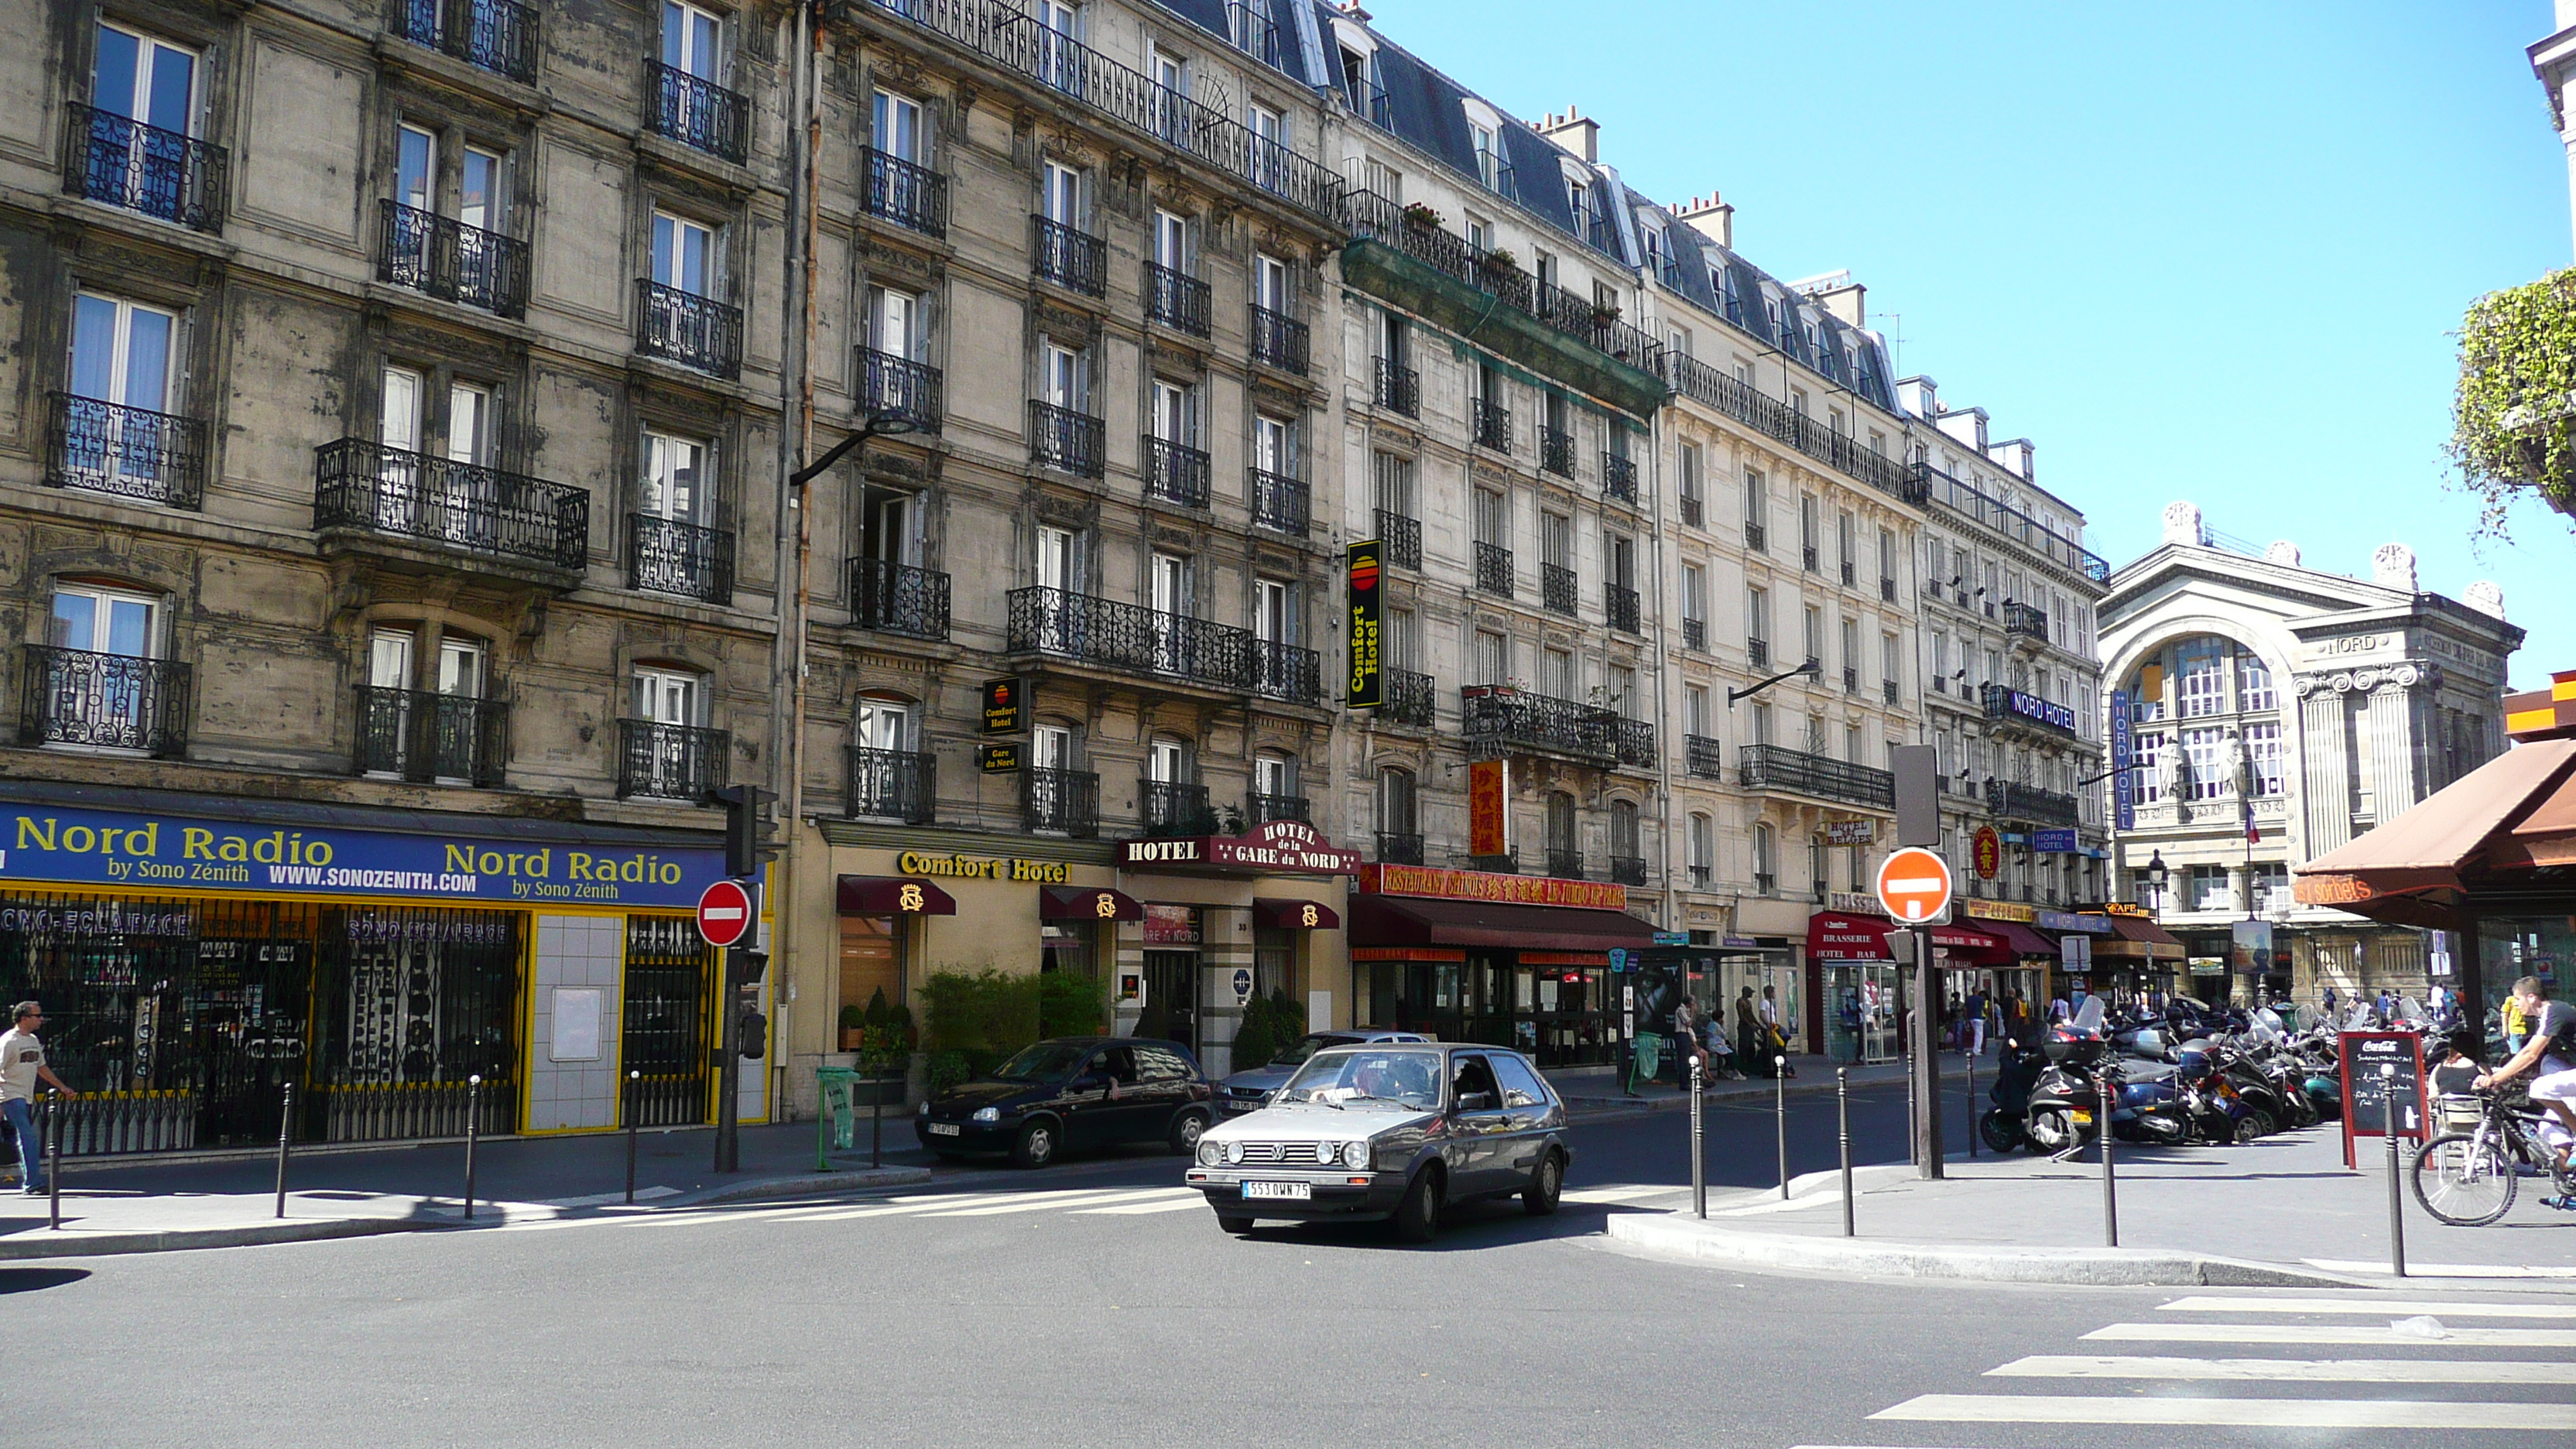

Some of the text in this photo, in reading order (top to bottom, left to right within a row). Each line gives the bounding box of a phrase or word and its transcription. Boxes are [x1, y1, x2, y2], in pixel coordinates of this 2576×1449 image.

[1351, 605, 1364, 692] Comfort
[1365, 619, 1377, 674] Hotel
[2328, 636, 2376, 654] NORD
[985, 707, 1017, 718] Comfort
[991, 718, 1011, 728] Hotel
[2014, 693, 2075, 731] NORD HOTEL
[985, 758, 1015, 768] du Nord
[992, 749, 1009, 758] Gare
[2115, 706, 2129, 828] NORD HOTEL
[1264, 821, 1316, 846] HOTEL
[1831, 820, 1867, 831] HOTEL
[15, 816, 334, 867] Nord Radio
[1278, 839, 1300, 851] de la
[1828, 834, 1872, 845] BELGES
[1127, 841, 1201, 862] HOTEL
[1235, 845, 1340, 869] GARE du NORD
[107, 857, 250, 882] by Sono Zénith
[444, 844, 682, 885] Nord Radio
[899, 851, 1073, 882] Comfort Hotel
[269, 865, 477, 892] WWW.SONOZENITH.COM
[512, 879, 619, 899] by Sono Zénith
[1384, 868, 1484, 896] RESTAURANT CHINOIS
[1546, 882, 1625, 907] LE JUMBO DE PARIS
[2314, 878, 2372, 902] sorbets
[1143, 930, 1160, 942] ARE
[1173, 930, 1200, 942] NORD
[1823, 934, 1872, 944] BRASSERIE
[1817, 950, 1845, 958] HOTEL
[1251, 1183, 1270, 1195] 553
[1295, 1184, 1308, 1197] 75
